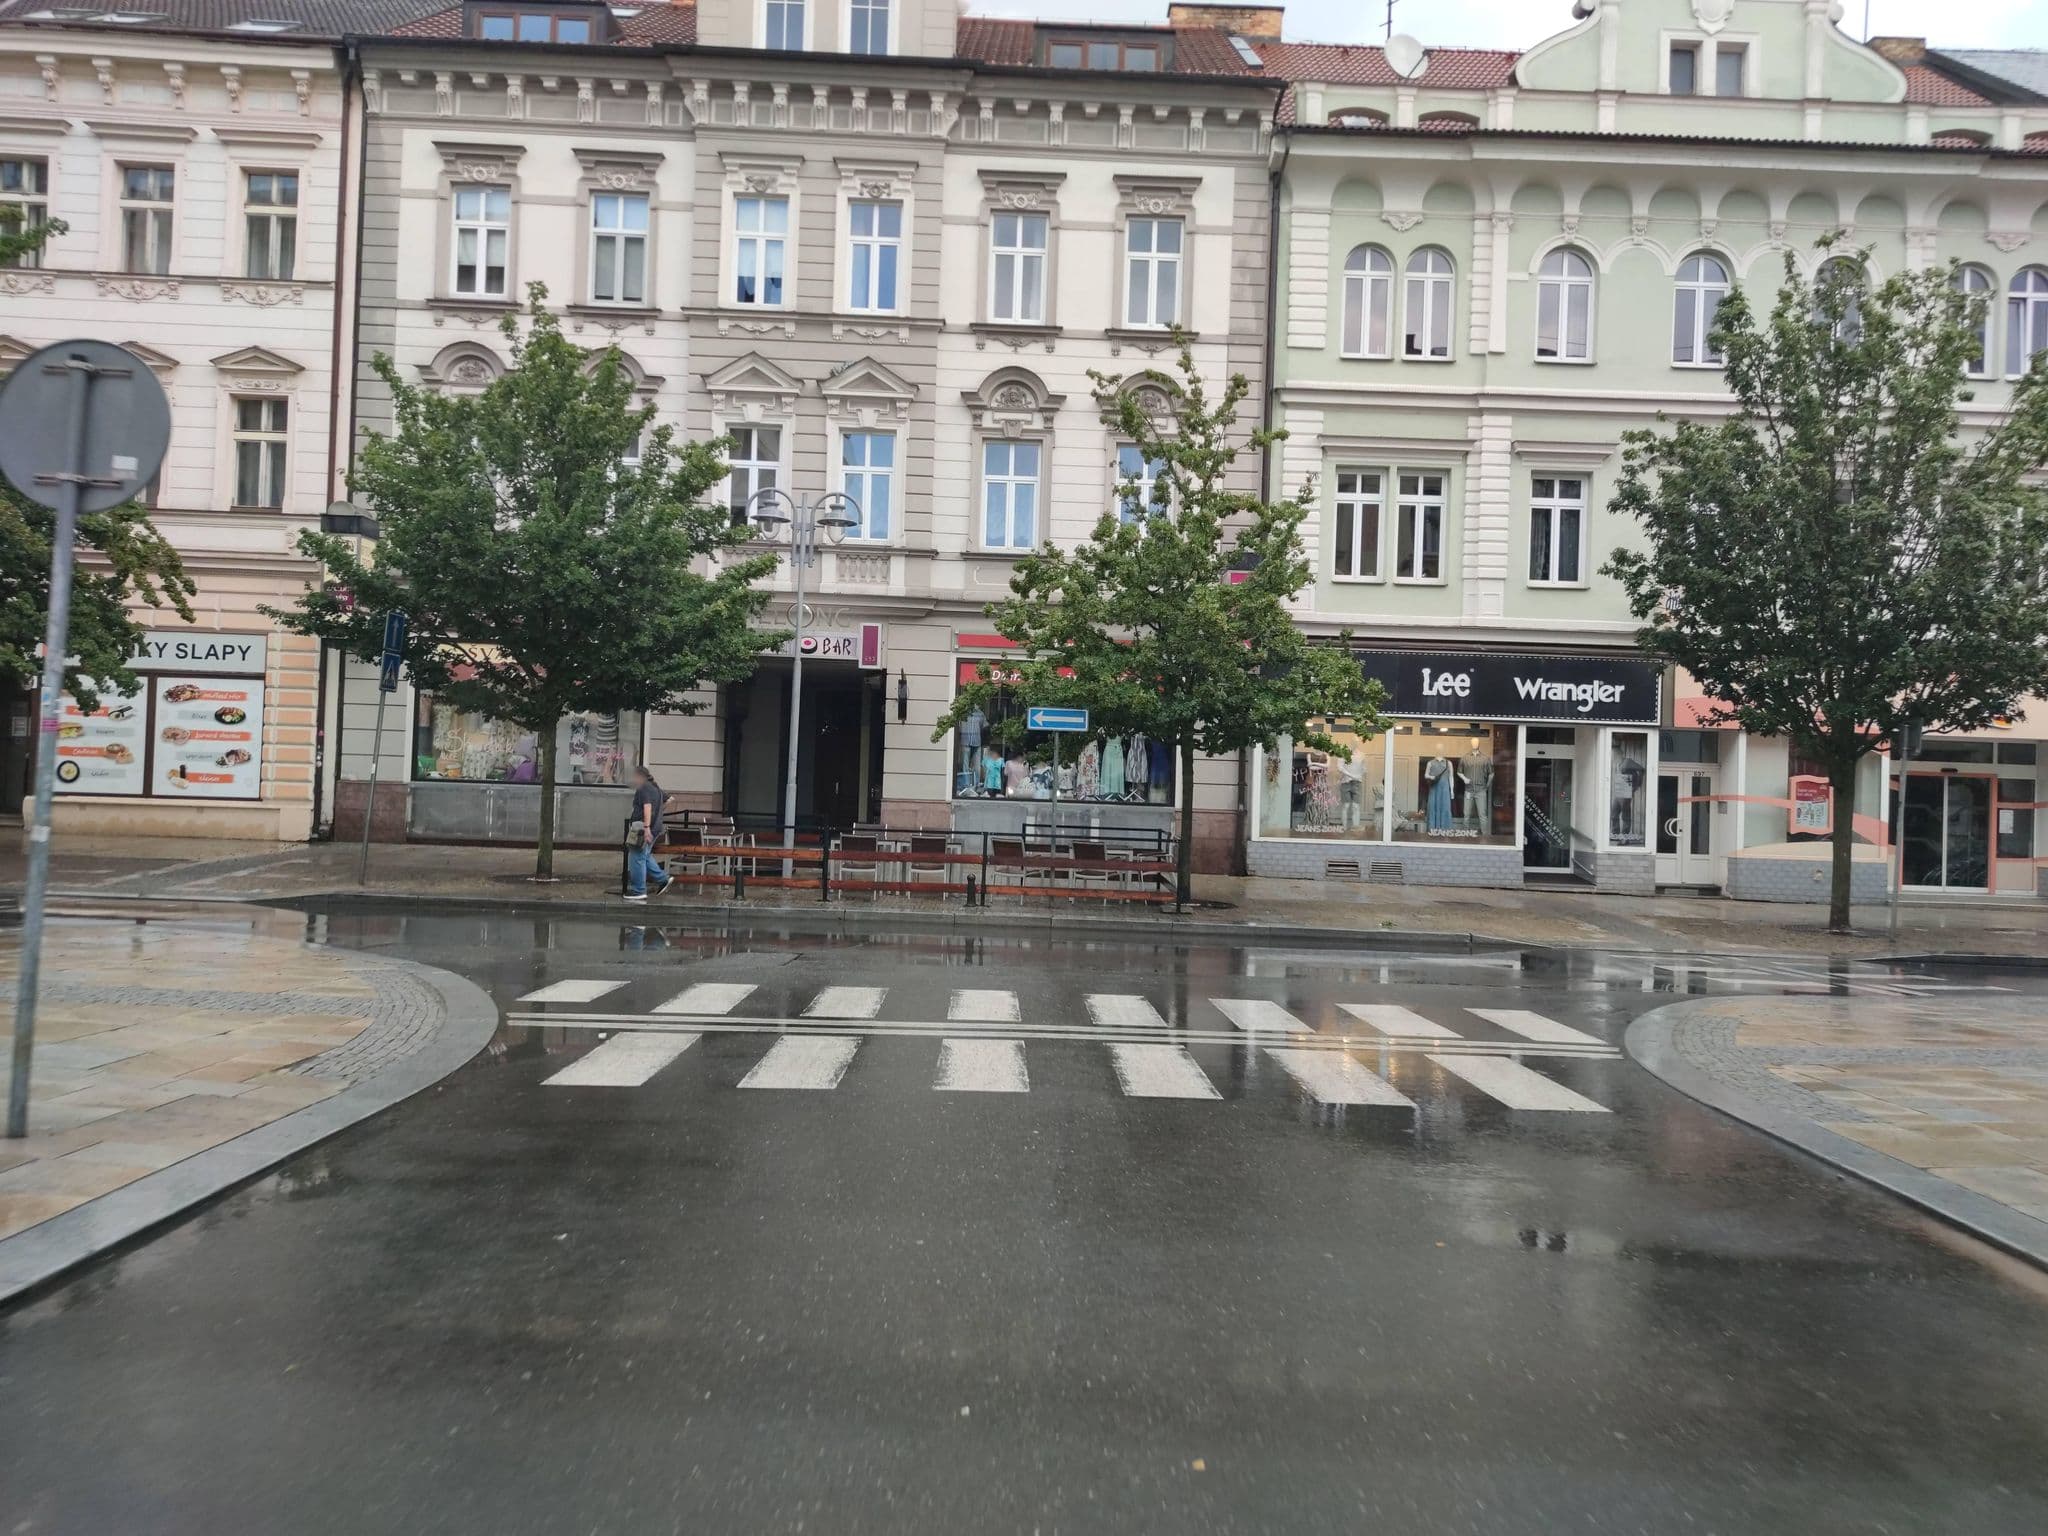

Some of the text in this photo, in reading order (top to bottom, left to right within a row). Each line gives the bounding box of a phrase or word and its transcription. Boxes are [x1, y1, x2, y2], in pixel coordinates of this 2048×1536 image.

[175, 642, 252, 661] SLAPY
[822, 637, 851, 655] BAR
[1421, 667, 1471, 697] Lee
[1513, 676, 1625, 713] Wrangler
